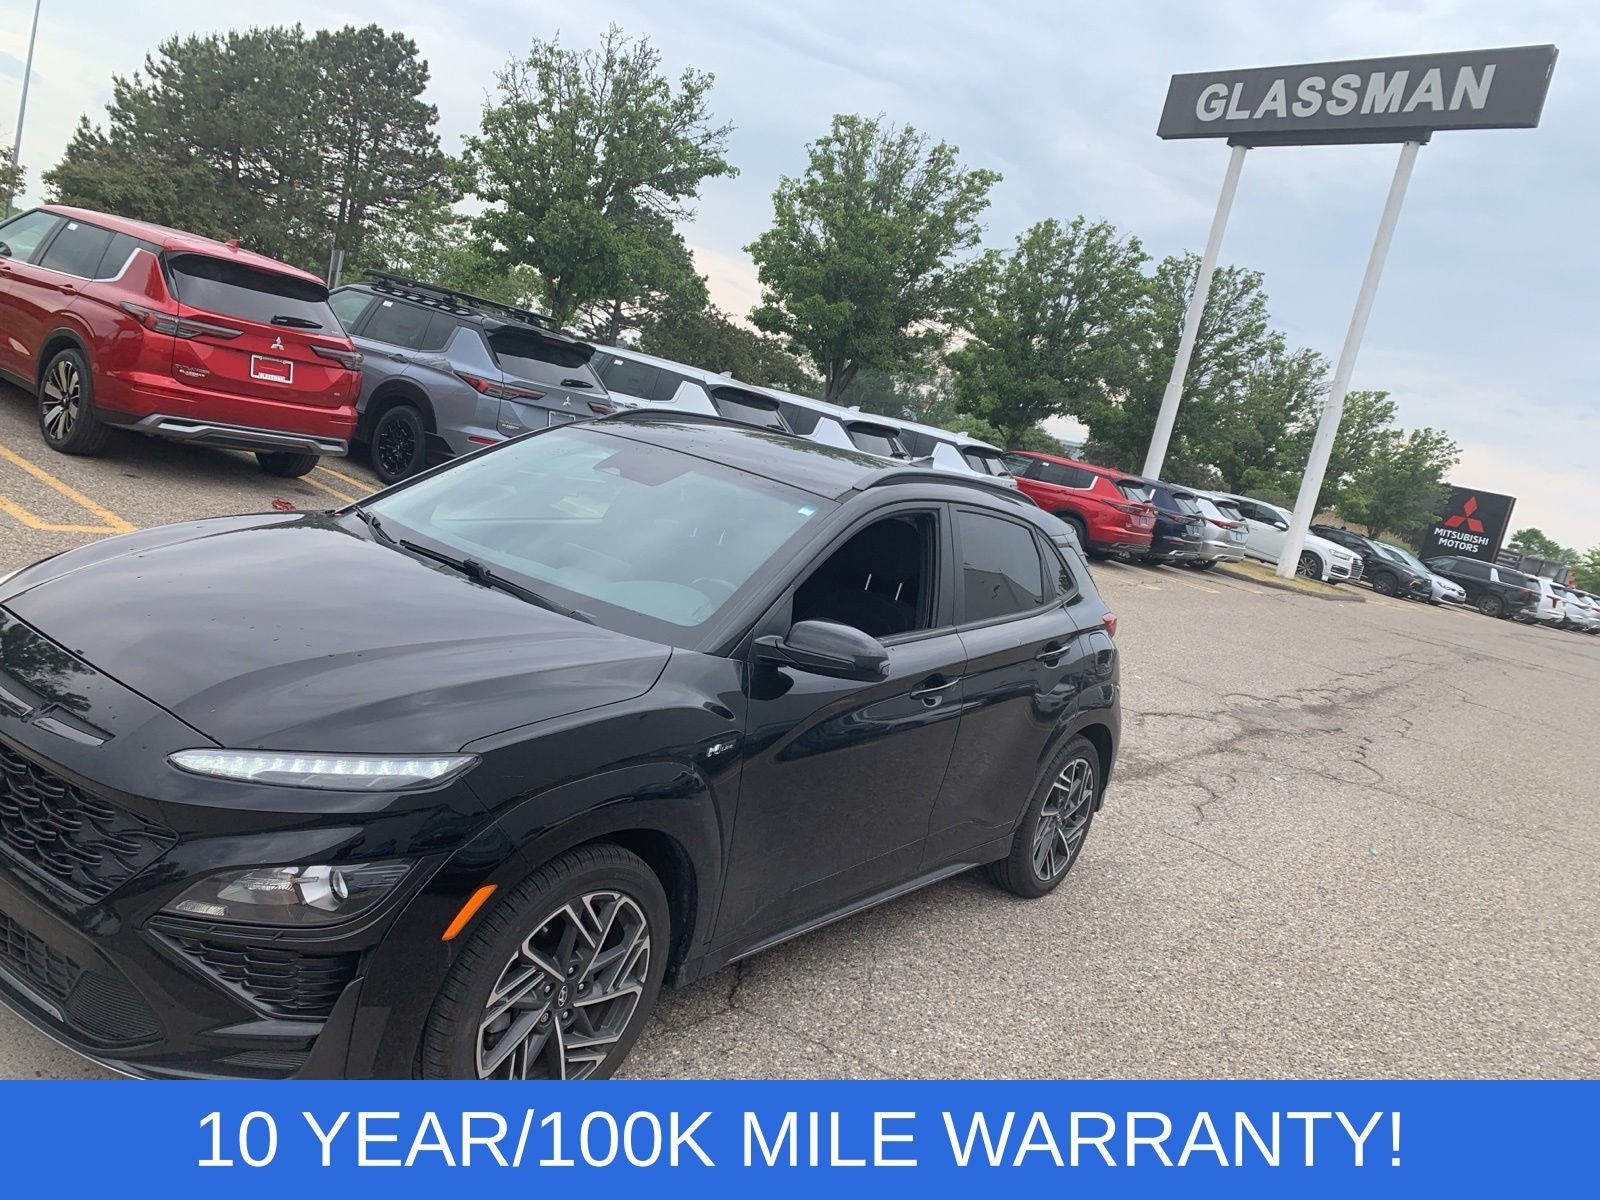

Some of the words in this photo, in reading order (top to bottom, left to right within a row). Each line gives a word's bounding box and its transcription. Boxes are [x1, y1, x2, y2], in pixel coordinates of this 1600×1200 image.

[1196, 64, 1496, 121] GLASSMAN
[1434, 527, 1489, 545] MITSUBISHI
[1438, 537, 1479, 552] MOTORS
